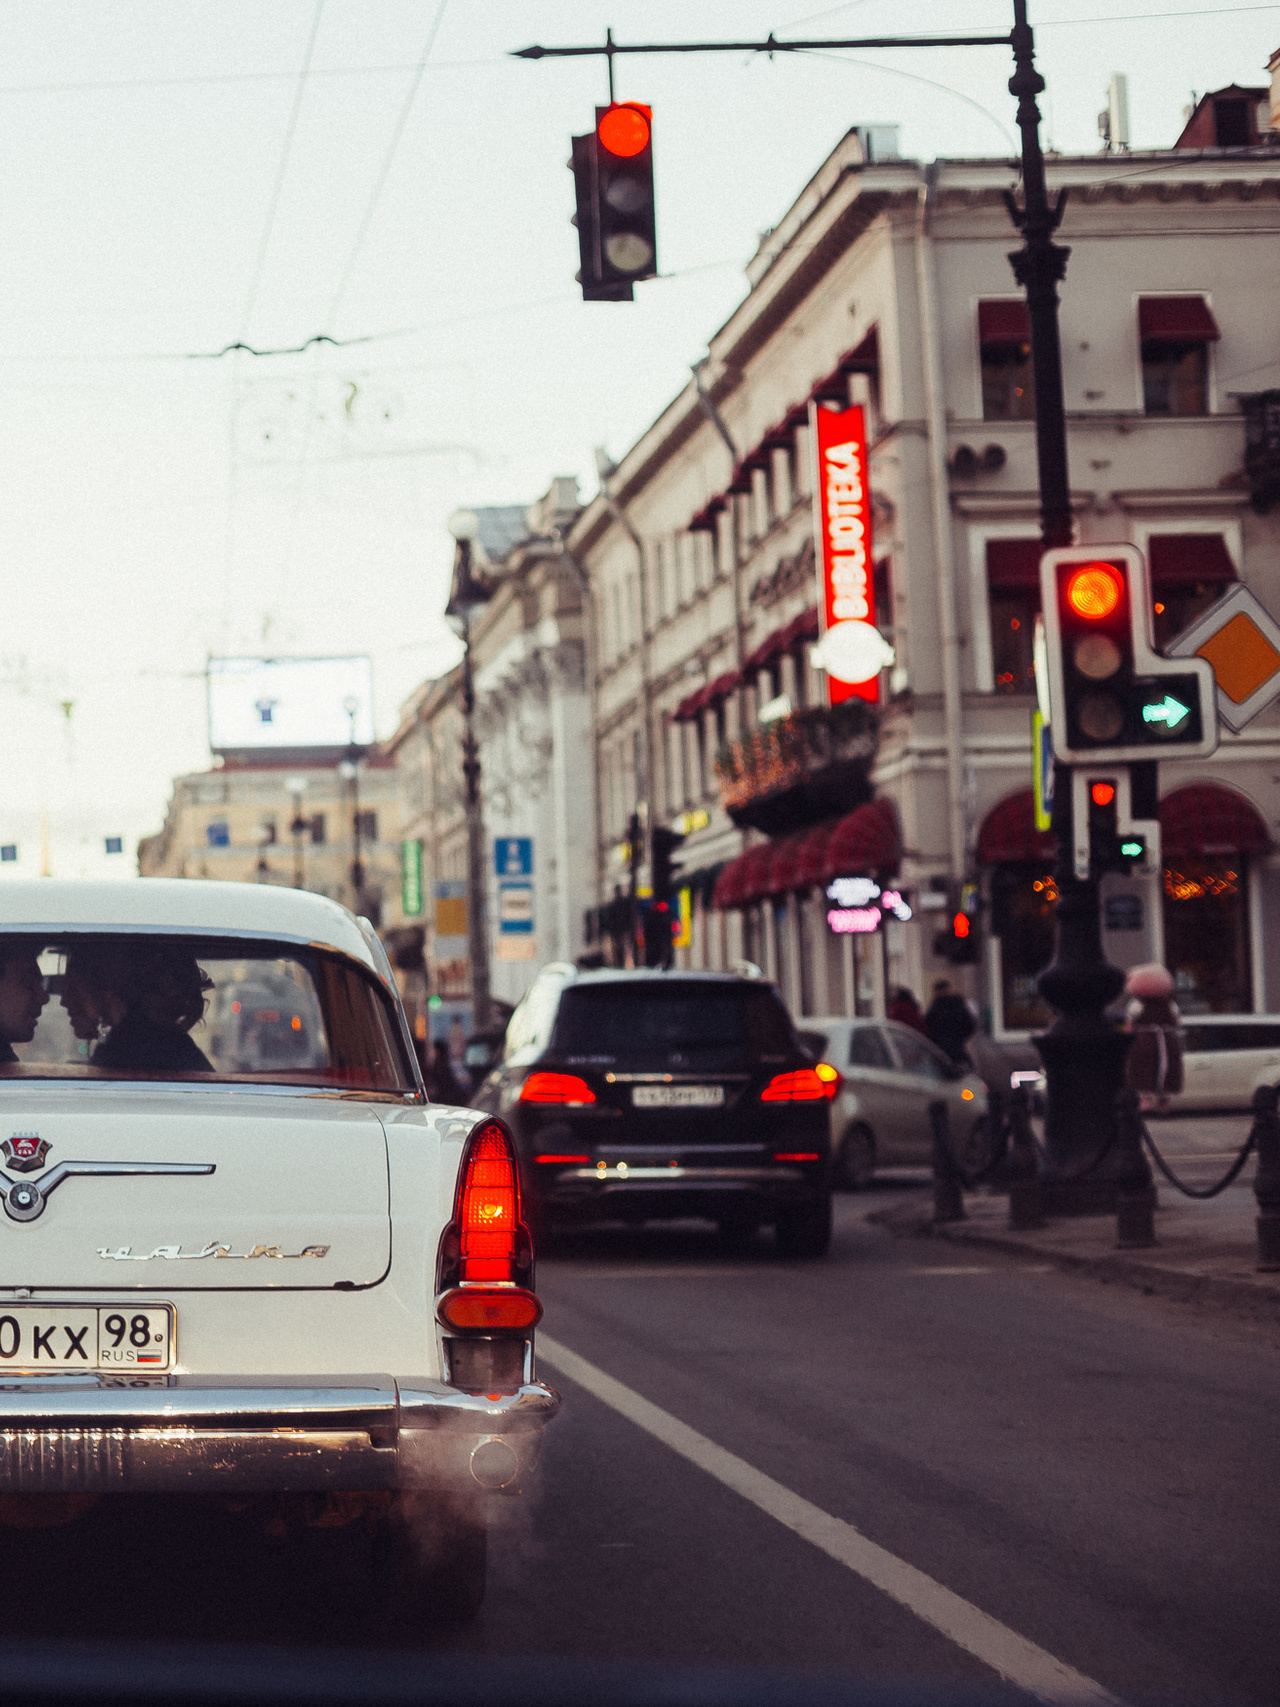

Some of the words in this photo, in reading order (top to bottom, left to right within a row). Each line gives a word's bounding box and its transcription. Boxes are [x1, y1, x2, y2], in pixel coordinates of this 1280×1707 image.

[825, 441, 869, 620] BIBLIOTEKA
[104, 1313, 151, 1348] 98
[101, 1349, 136, 1363] RUS
